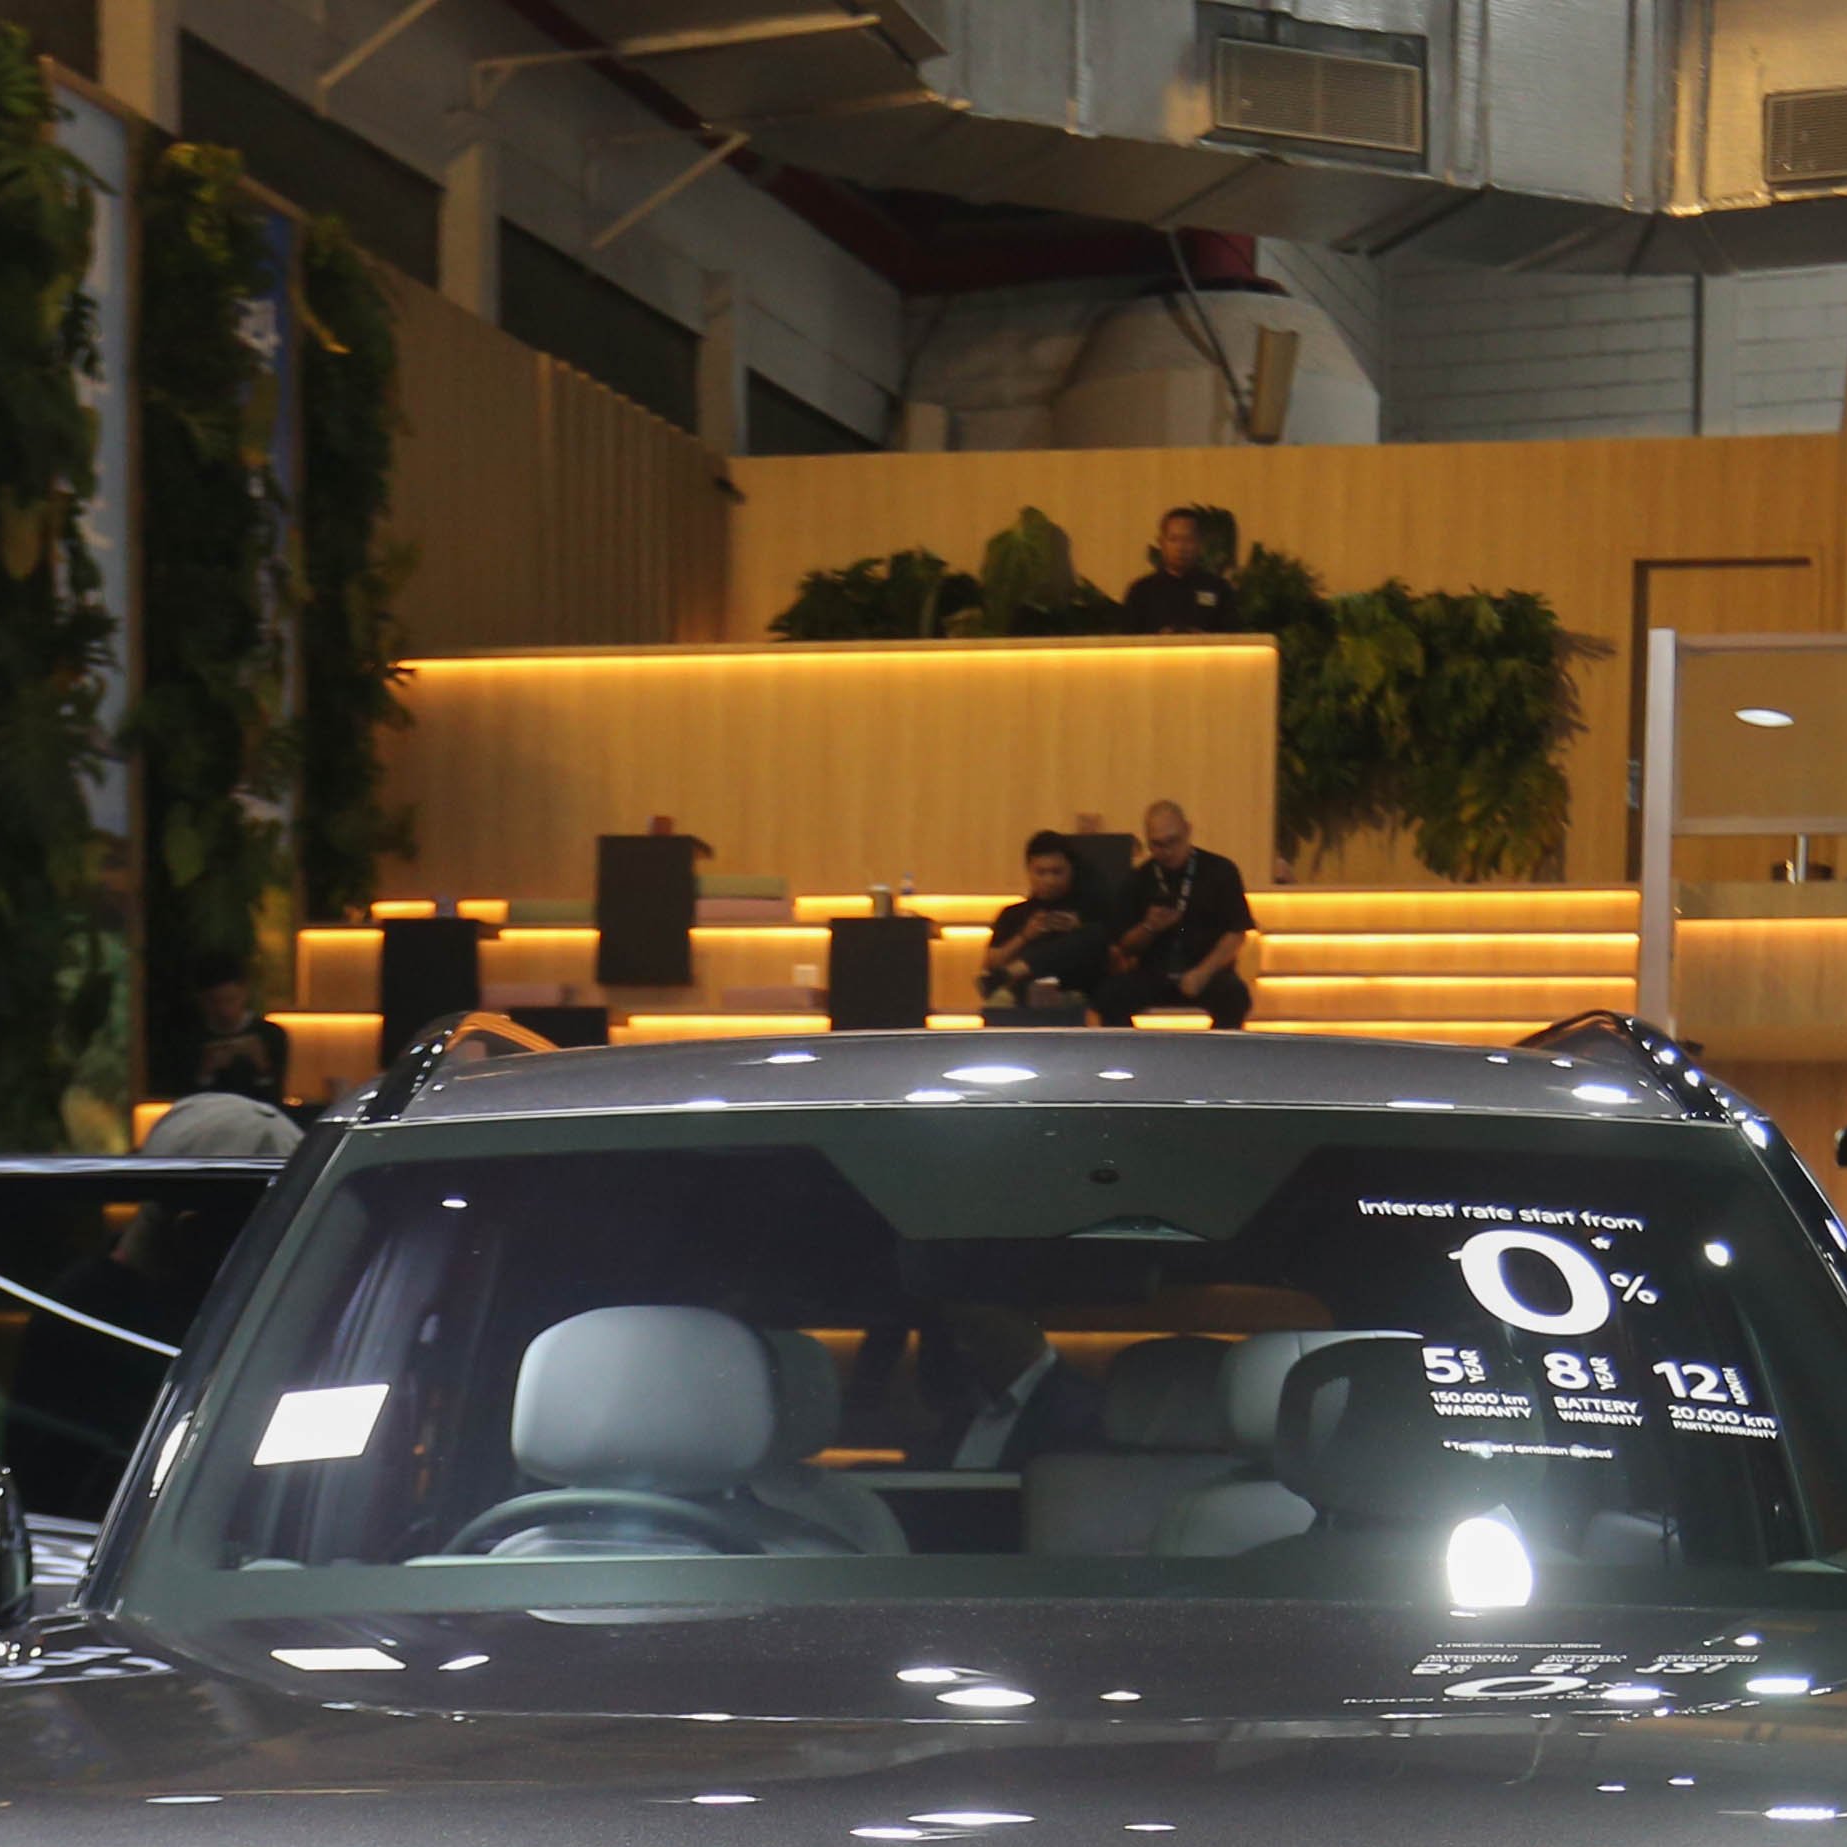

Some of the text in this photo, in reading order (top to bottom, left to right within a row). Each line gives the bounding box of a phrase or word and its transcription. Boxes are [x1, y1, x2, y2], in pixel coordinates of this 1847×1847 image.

[1358, 1199, 1644, 1232] Interest rate start from
[1422, 1346, 1465, 1384] 5
[1459, 1349, 1487, 1384] YEAR
[1543, 1352, 1590, 1390] 8
[1589, 1356, 1617, 1391] YEAR
[1652, 1361, 1728, 1403] 12
[1430, 1391, 1529, 1406] 150.000 km
[1433, 1403, 1532, 1419] WARRANTY
[1553, 1396, 1639, 1414] BATTERY
[1557, 1410, 1644, 1427] WARRANTY
[1667, 1405, 1776, 1429] 20.000 km
[1673, 1420, 1779, 1440] PARTS WARRANTY
